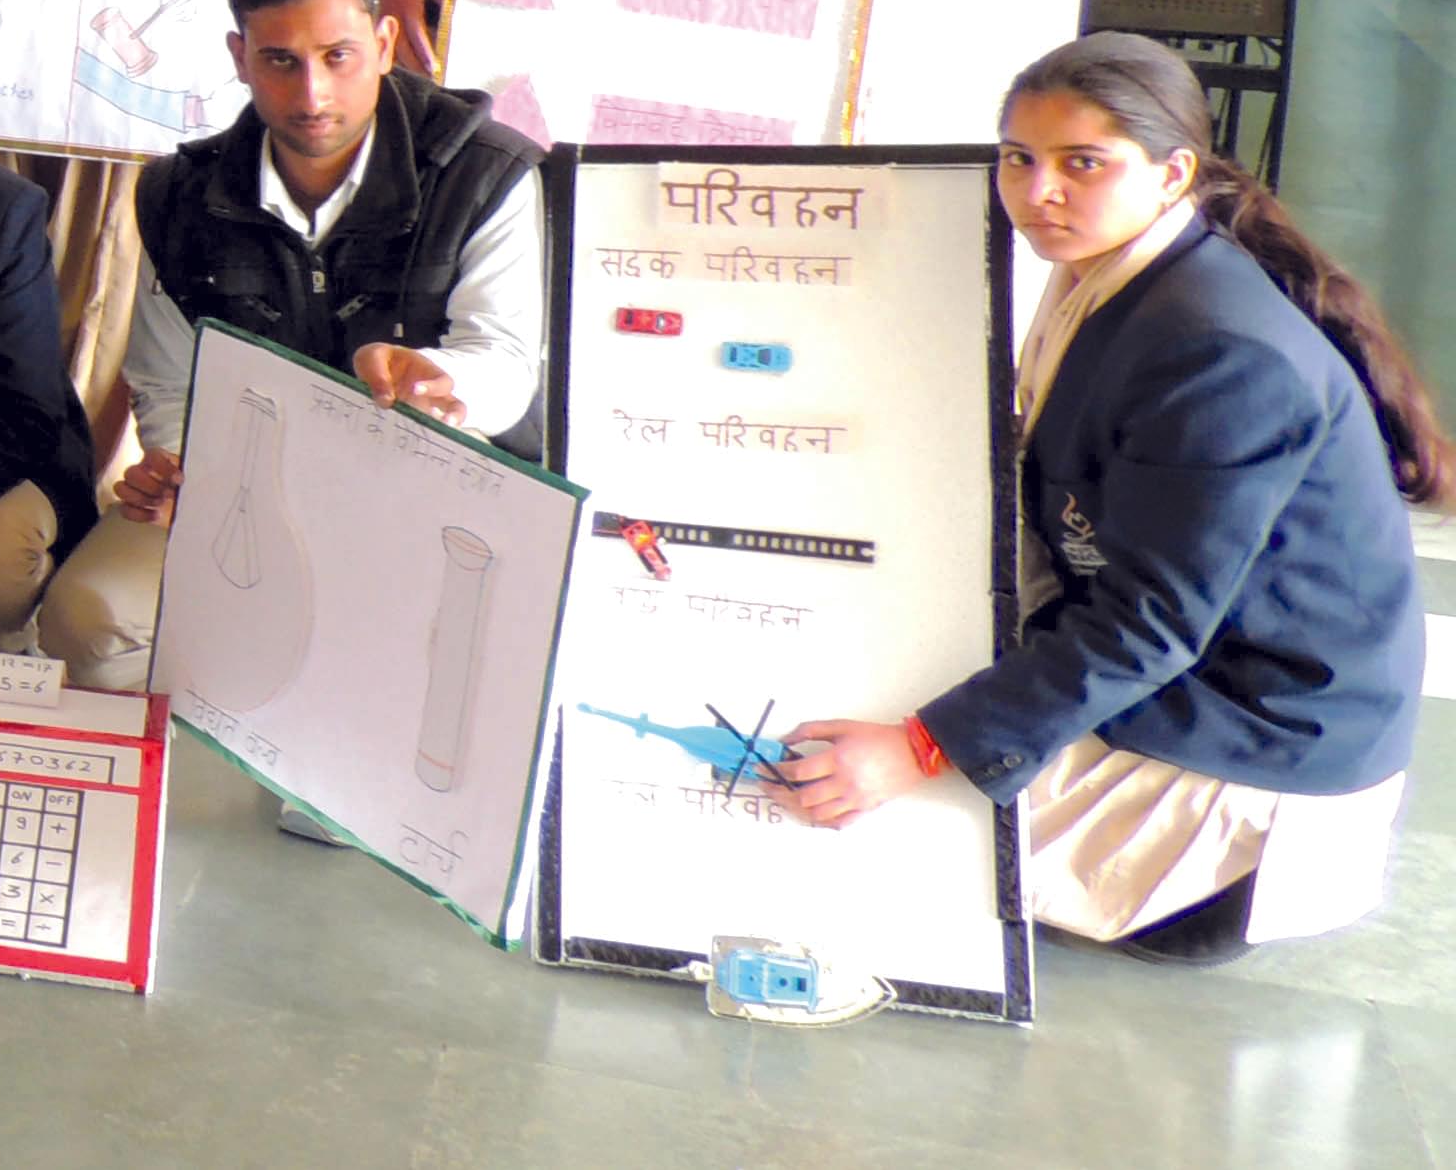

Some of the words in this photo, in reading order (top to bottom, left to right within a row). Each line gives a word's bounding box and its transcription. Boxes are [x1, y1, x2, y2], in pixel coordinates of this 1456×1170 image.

[661, 168, 864, 229] परिवहन
[703, 245, 852, 285] परिवहन
[612, 408, 676, 444] रेल
[698, 415, 847, 455] परिवहन
[11, 789, 33, 802] ON
[48, 794, 75, 807] OFF
[679, 779, 785, 825] परिवह
[1, 884, 22, 899] 3
